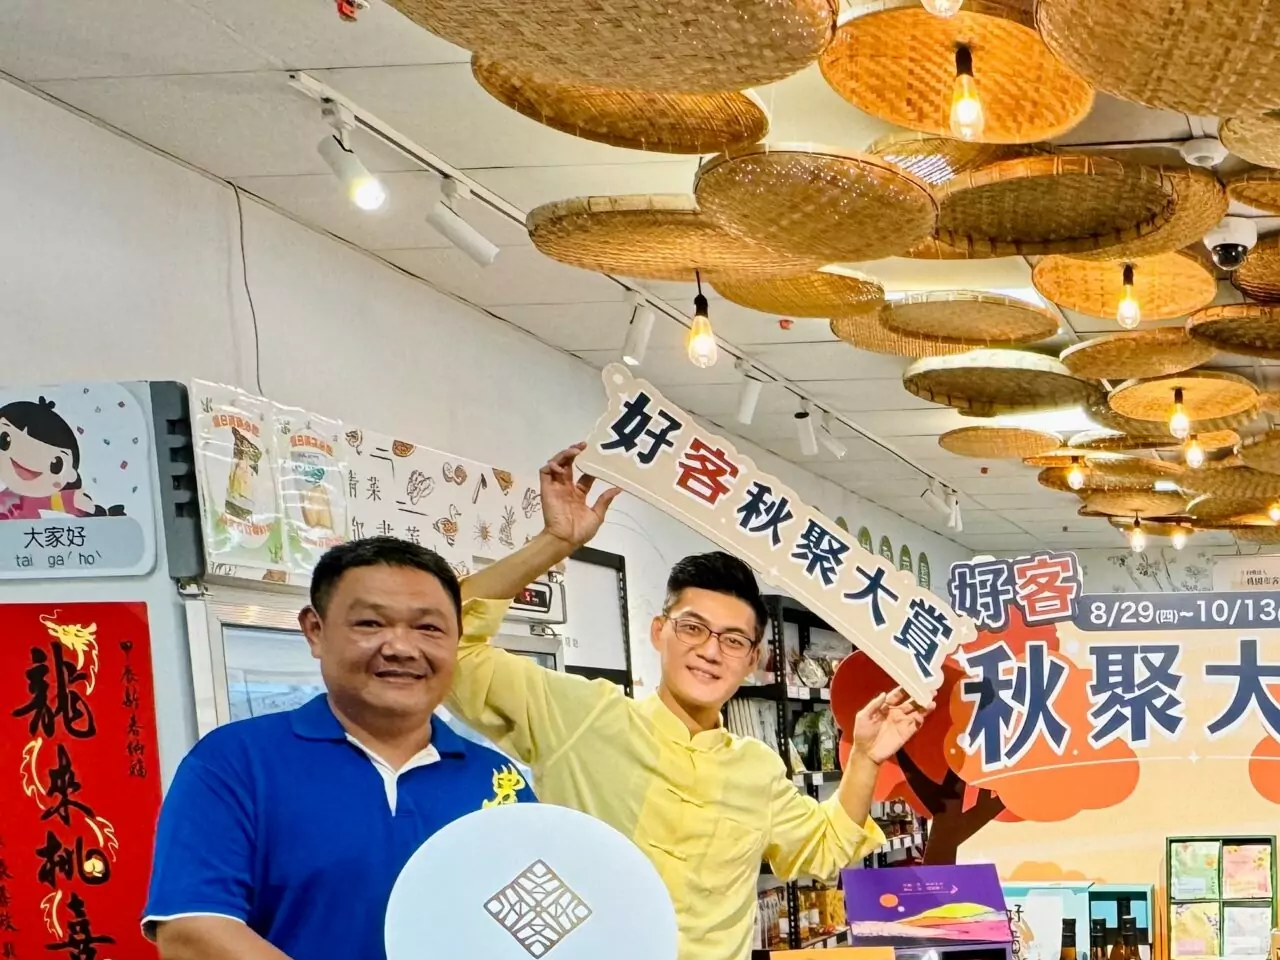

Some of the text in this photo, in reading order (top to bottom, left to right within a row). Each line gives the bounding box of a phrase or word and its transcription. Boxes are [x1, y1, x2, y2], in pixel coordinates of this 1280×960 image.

[23, 526, 87, 549] 大家好
[601, 392, 954, 679] 好客秋聚大賞
[16, 554, 33, 567] tai
[954, 555, 1077, 627] 好客
